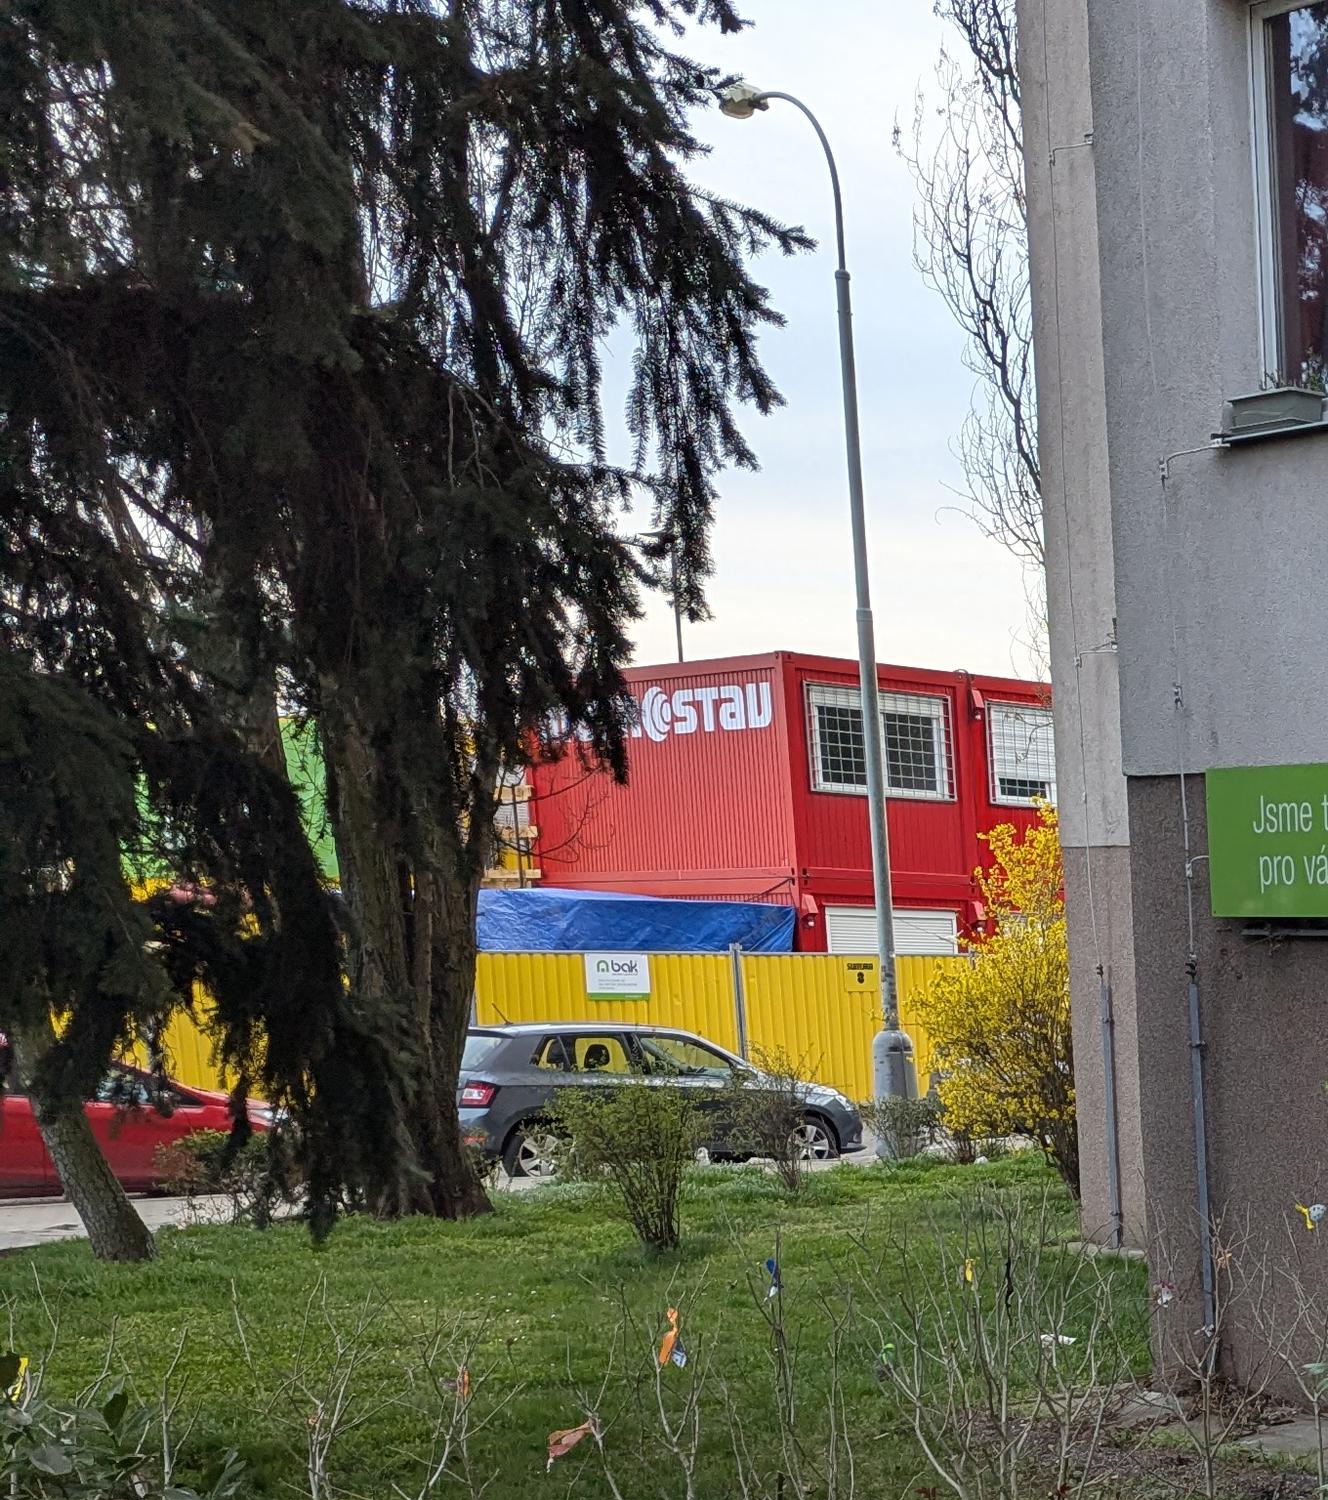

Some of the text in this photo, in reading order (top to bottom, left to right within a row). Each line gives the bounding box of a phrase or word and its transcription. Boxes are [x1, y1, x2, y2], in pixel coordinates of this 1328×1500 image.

[1253, 795, 1313, 833] Jsme
[1259, 853, 1295, 894] pro
[611, 960, 638, 973] bak
